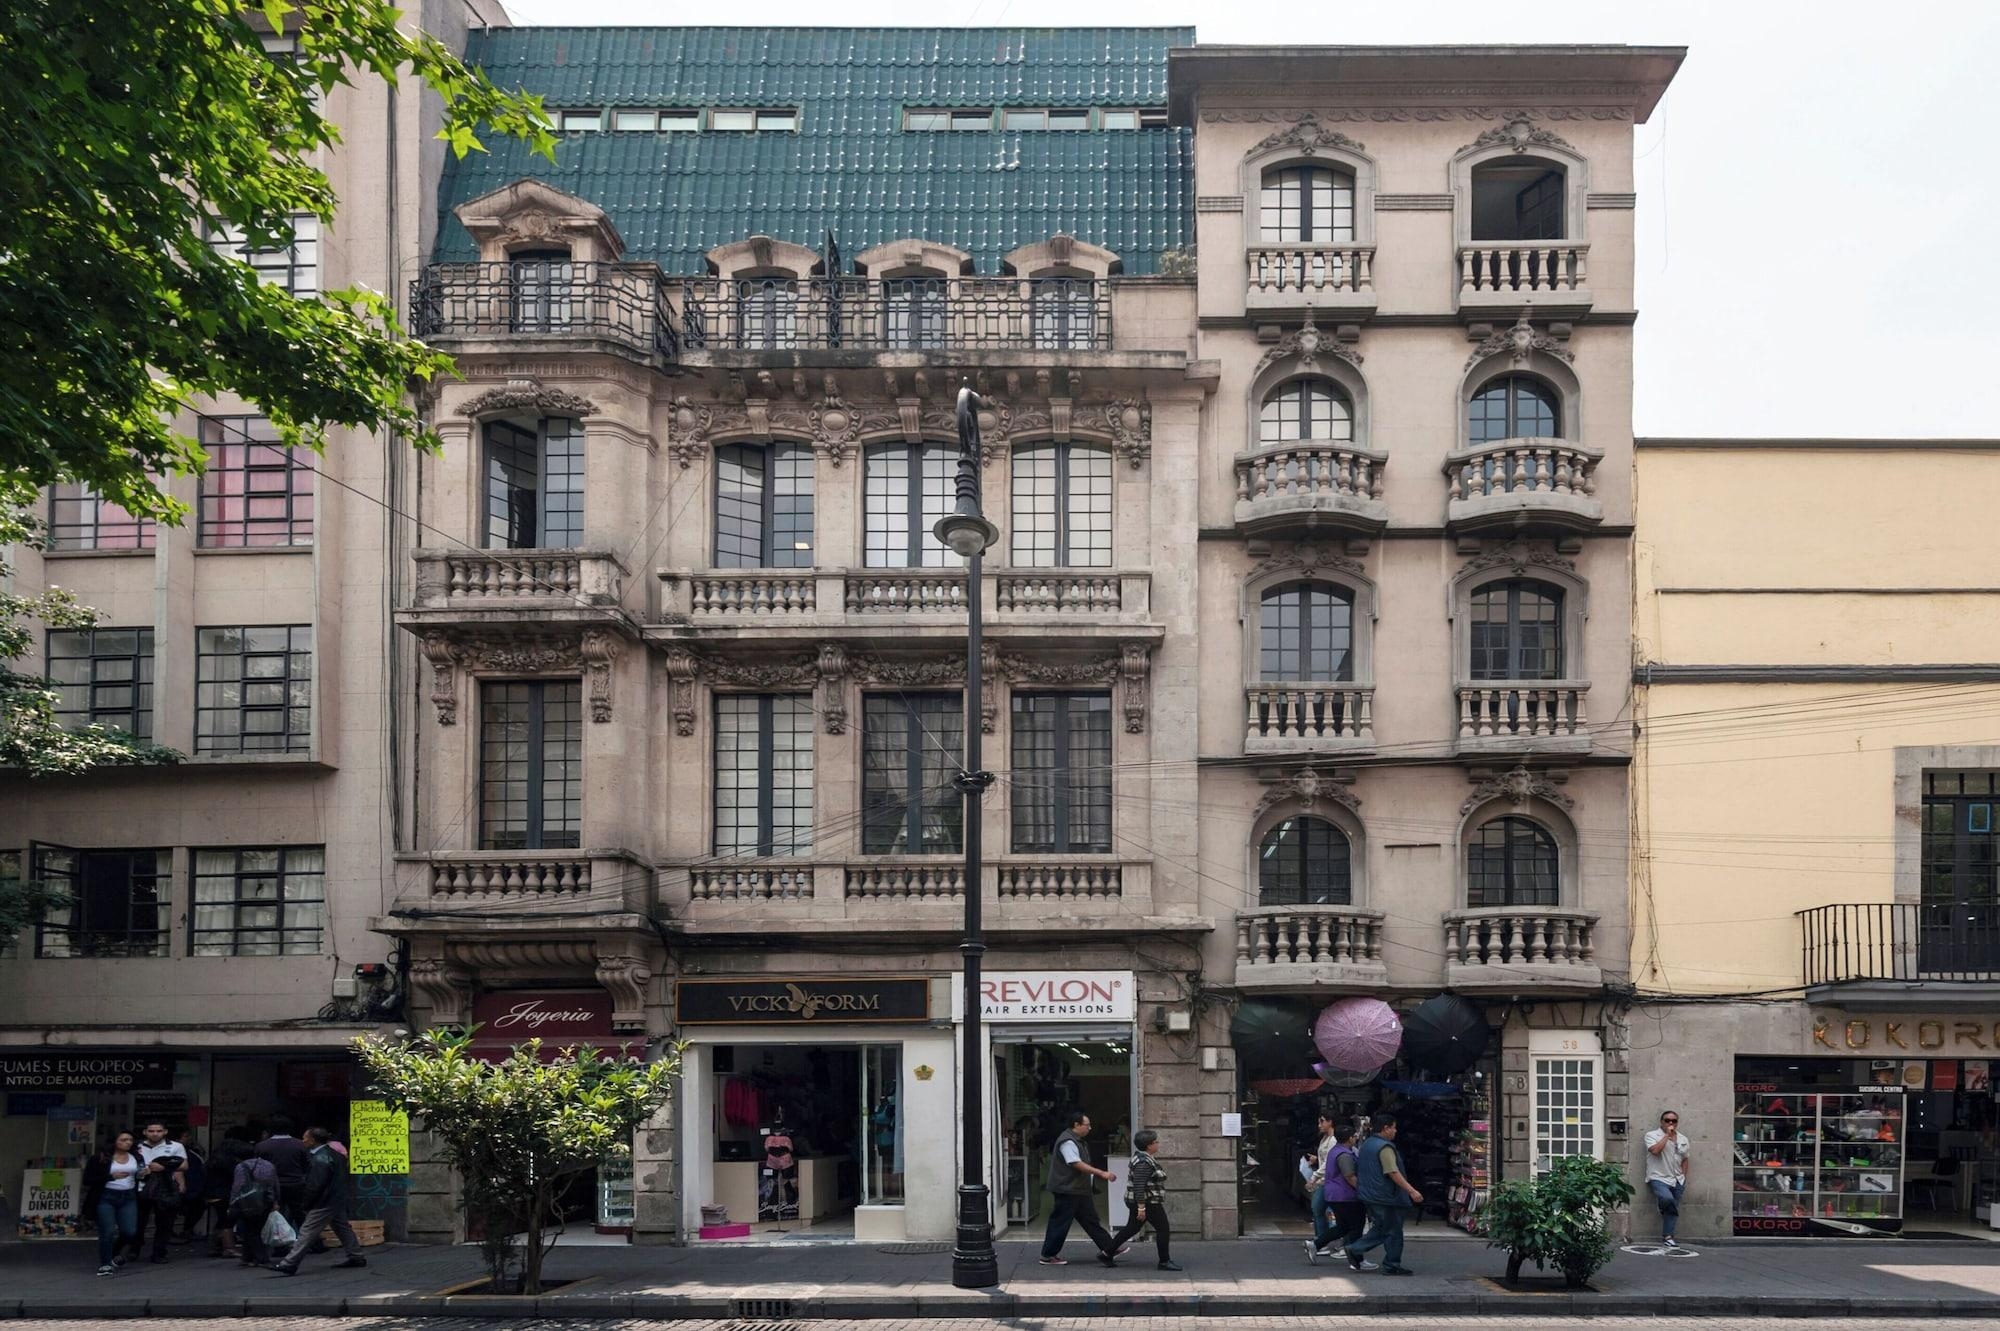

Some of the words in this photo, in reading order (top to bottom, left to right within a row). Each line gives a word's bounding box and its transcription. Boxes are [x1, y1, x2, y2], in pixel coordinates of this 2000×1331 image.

[980, 1005, 1010, 1014] AIR
[1022, 1005, 1113, 1014] EXTENSIONS
[58, 1059, 145, 1073] EUROPEOS
[46, 1075, 64, 1085] DE
[67, 1075, 133, 1085] MAYOREO
[352, 1144, 406, 1157] Temporada
[30, 1190, 37, 1200] Y
[39, 1190, 70, 1200] GANA
[28, 1200, 70, 1211] DINERO
